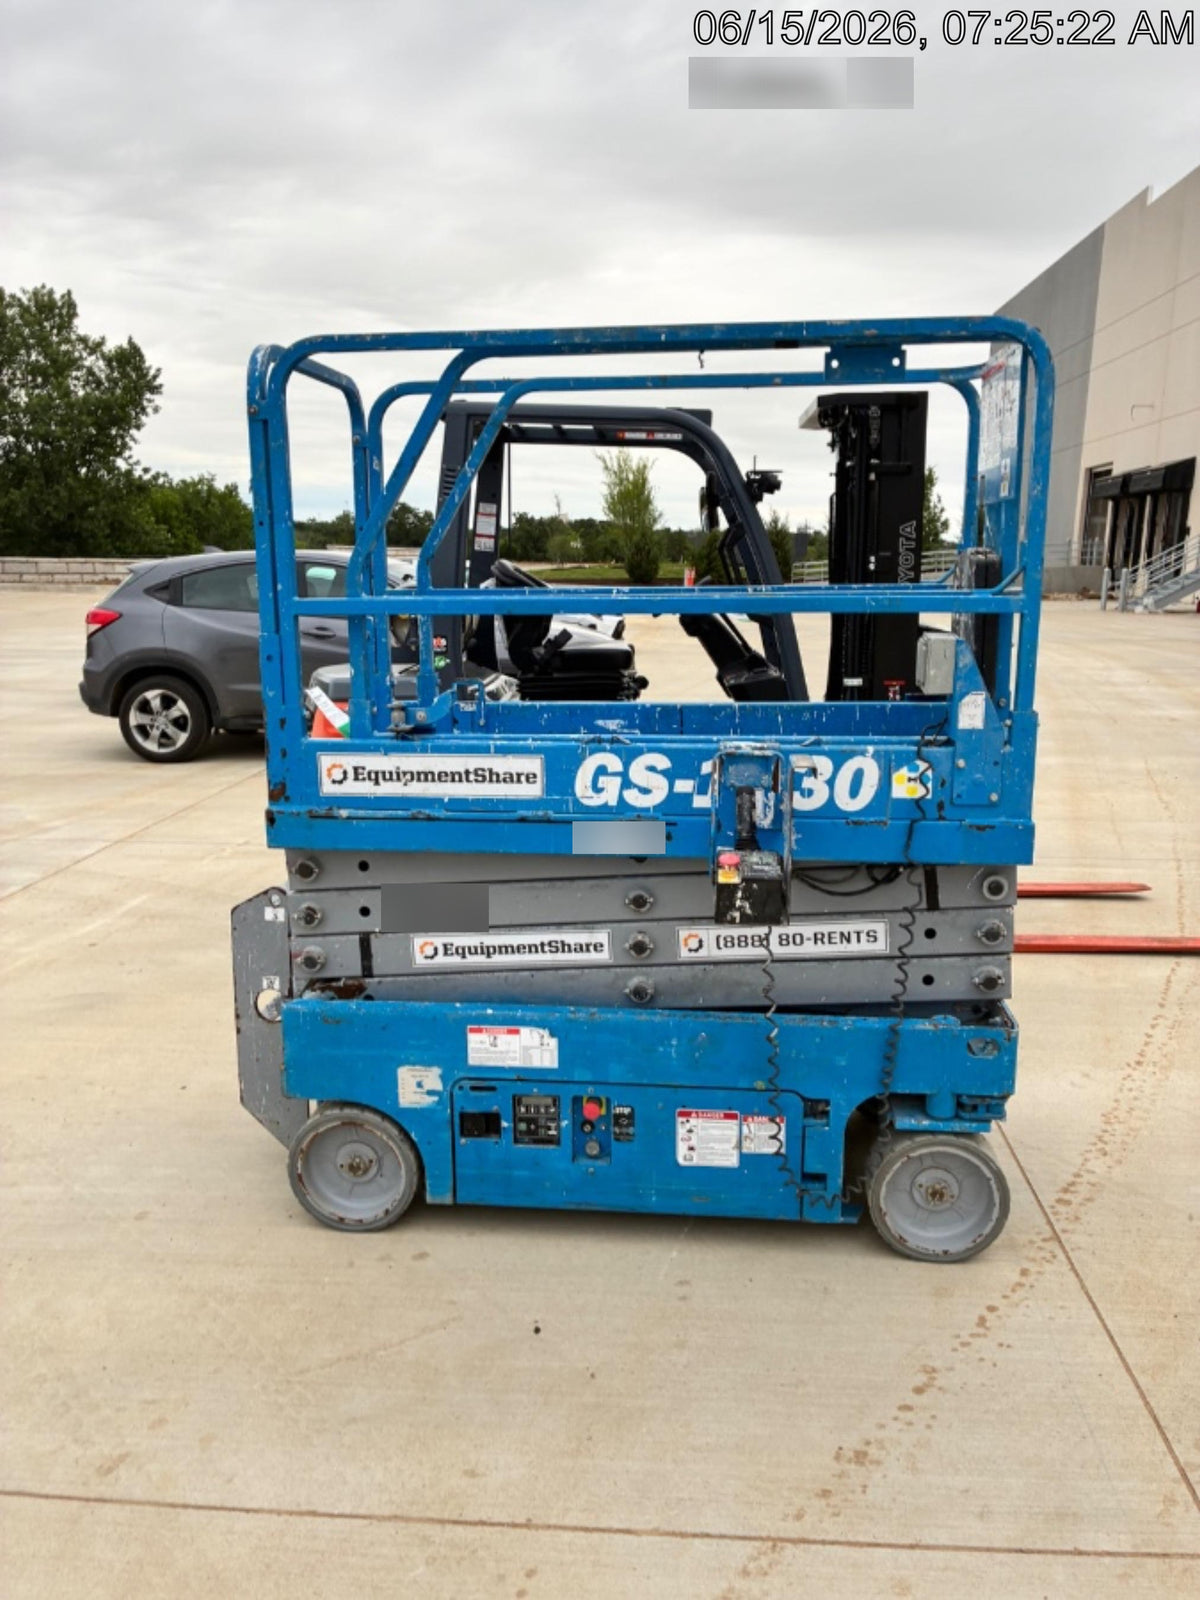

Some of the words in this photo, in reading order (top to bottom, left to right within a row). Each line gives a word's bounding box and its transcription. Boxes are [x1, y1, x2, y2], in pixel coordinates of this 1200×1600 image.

[898, 520, 916, 584] YOTA
[352, 765, 538, 786] EquipmentShare
[778, 928, 879, 947] 80-RENTS
[441, 939, 605, 959] EquipmentShare
